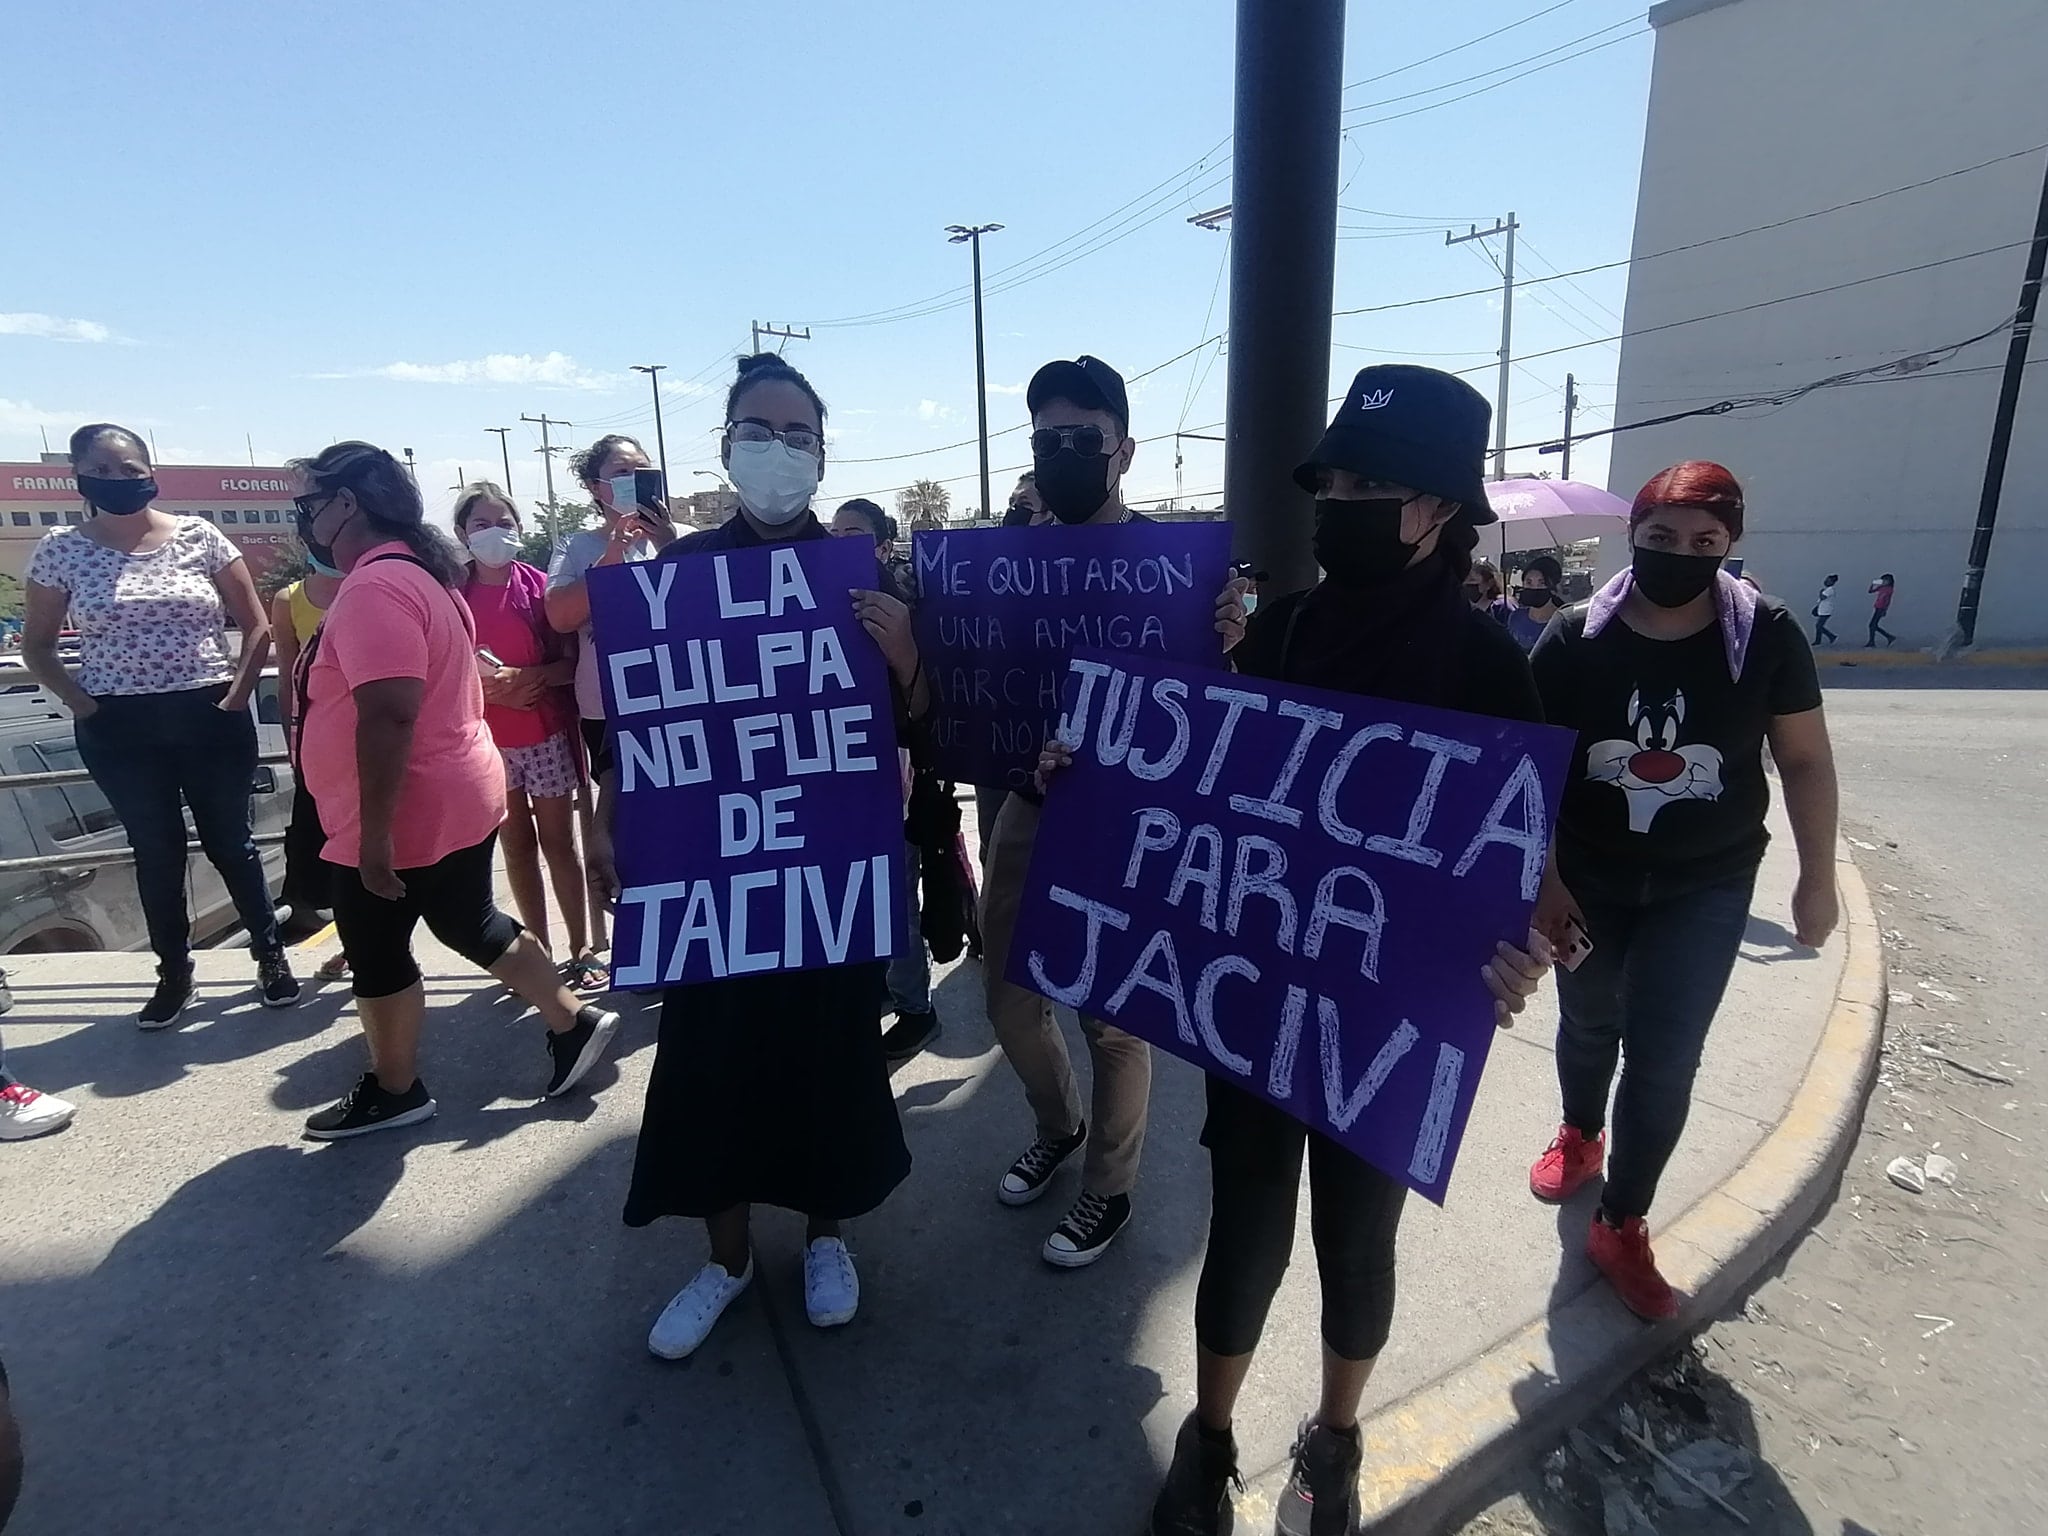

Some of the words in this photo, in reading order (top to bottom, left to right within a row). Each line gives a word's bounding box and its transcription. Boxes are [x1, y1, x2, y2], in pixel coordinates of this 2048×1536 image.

[631, 562, 678, 630] Y
[713, 547, 817, 619] LA
[987, 552, 1195, 597] QUITARON
[608, 626, 856, 716] CULPA
[938, 615, 1007, 650] UNA
[1034, 614, 1168, 652] AMIGA
[618, 719, 712, 792] NO
[733, 704, 878, 782] FUE
[991, 719, 1034, 755] NO
[1058, 657, 1548, 902] JUSTICIA
[718, 785, 805, 858] DE
[614, 854, 892, 987] JACIVI
[1121, 807, 1389, 984] PARA
[1027, 884, 1465, 1185] JACIVI
